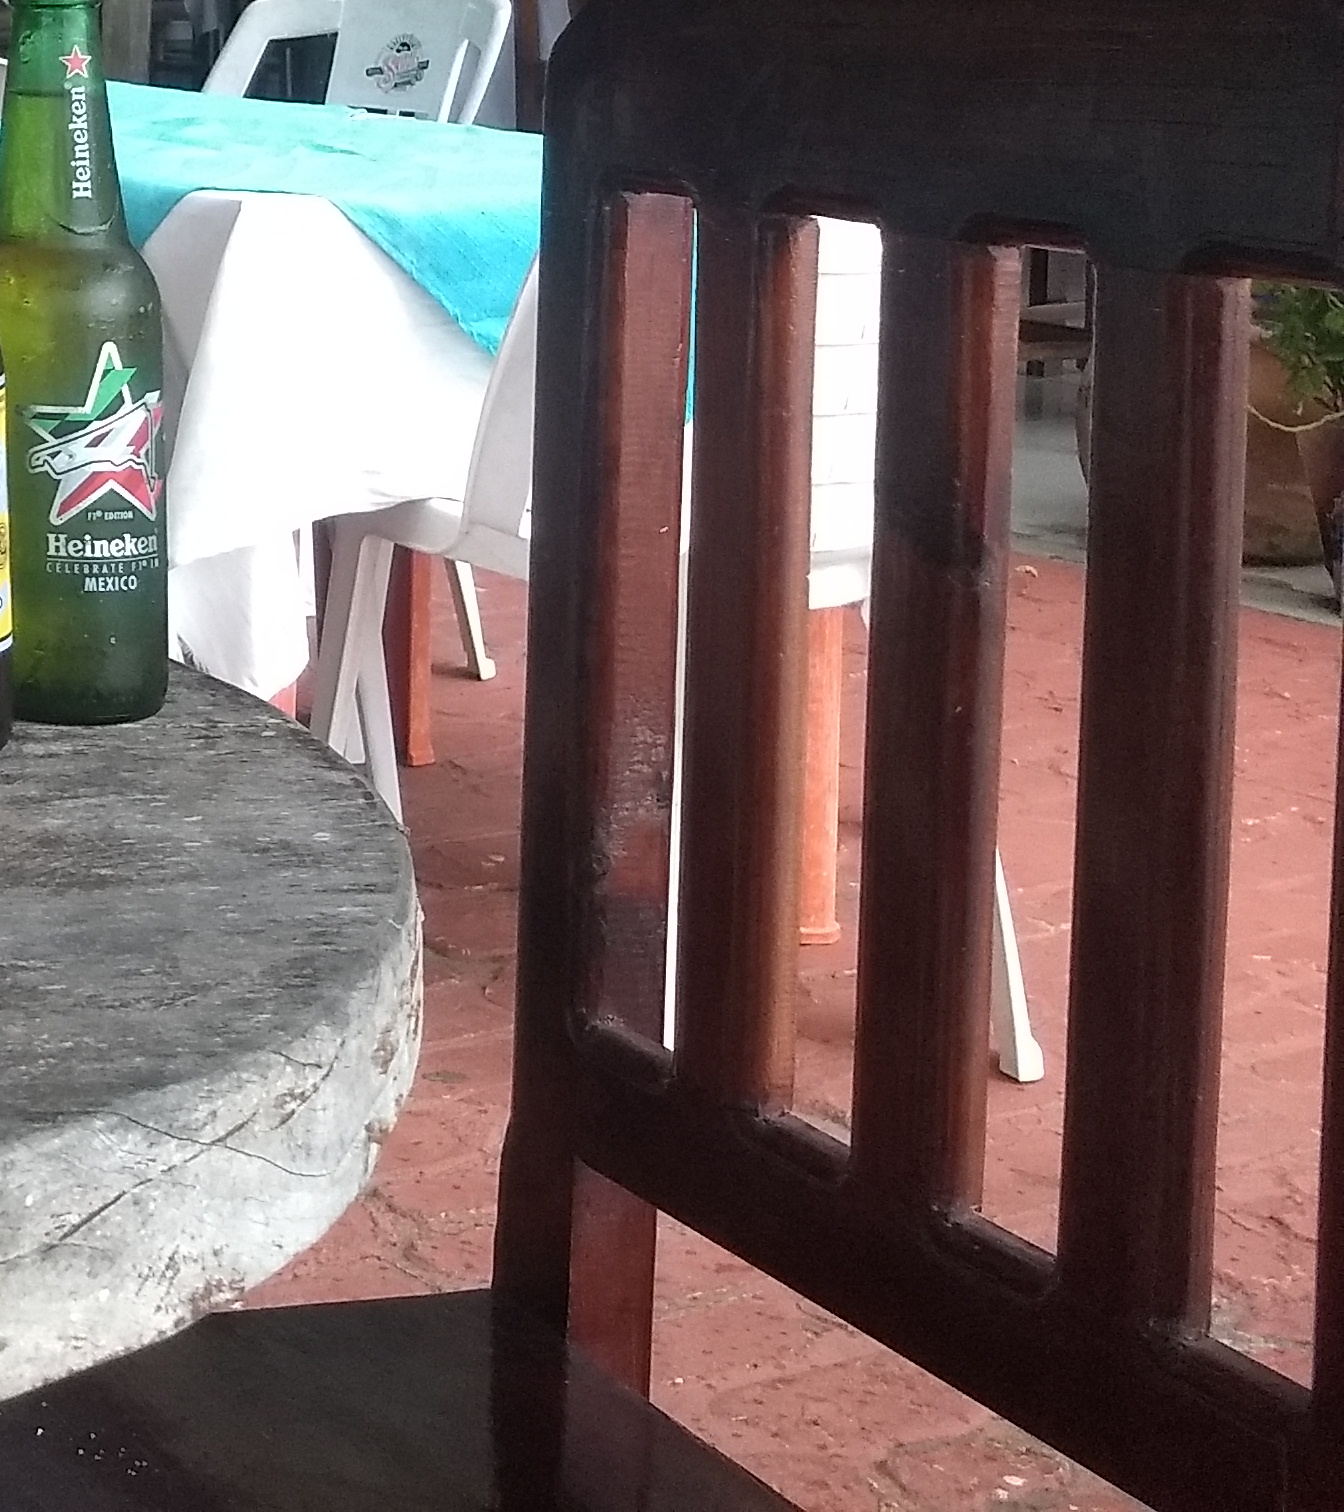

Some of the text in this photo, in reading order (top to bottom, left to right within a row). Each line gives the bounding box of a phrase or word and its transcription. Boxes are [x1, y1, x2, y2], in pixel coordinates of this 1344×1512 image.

[68, 85, 92, 199] Heineken
[104, 510, 133, 521] EDITION
[46, 531, 158, 558] Heineken
[46, 561, 124, 574] CELEBRATE
[84, 576, 138, 592] MEXICO
